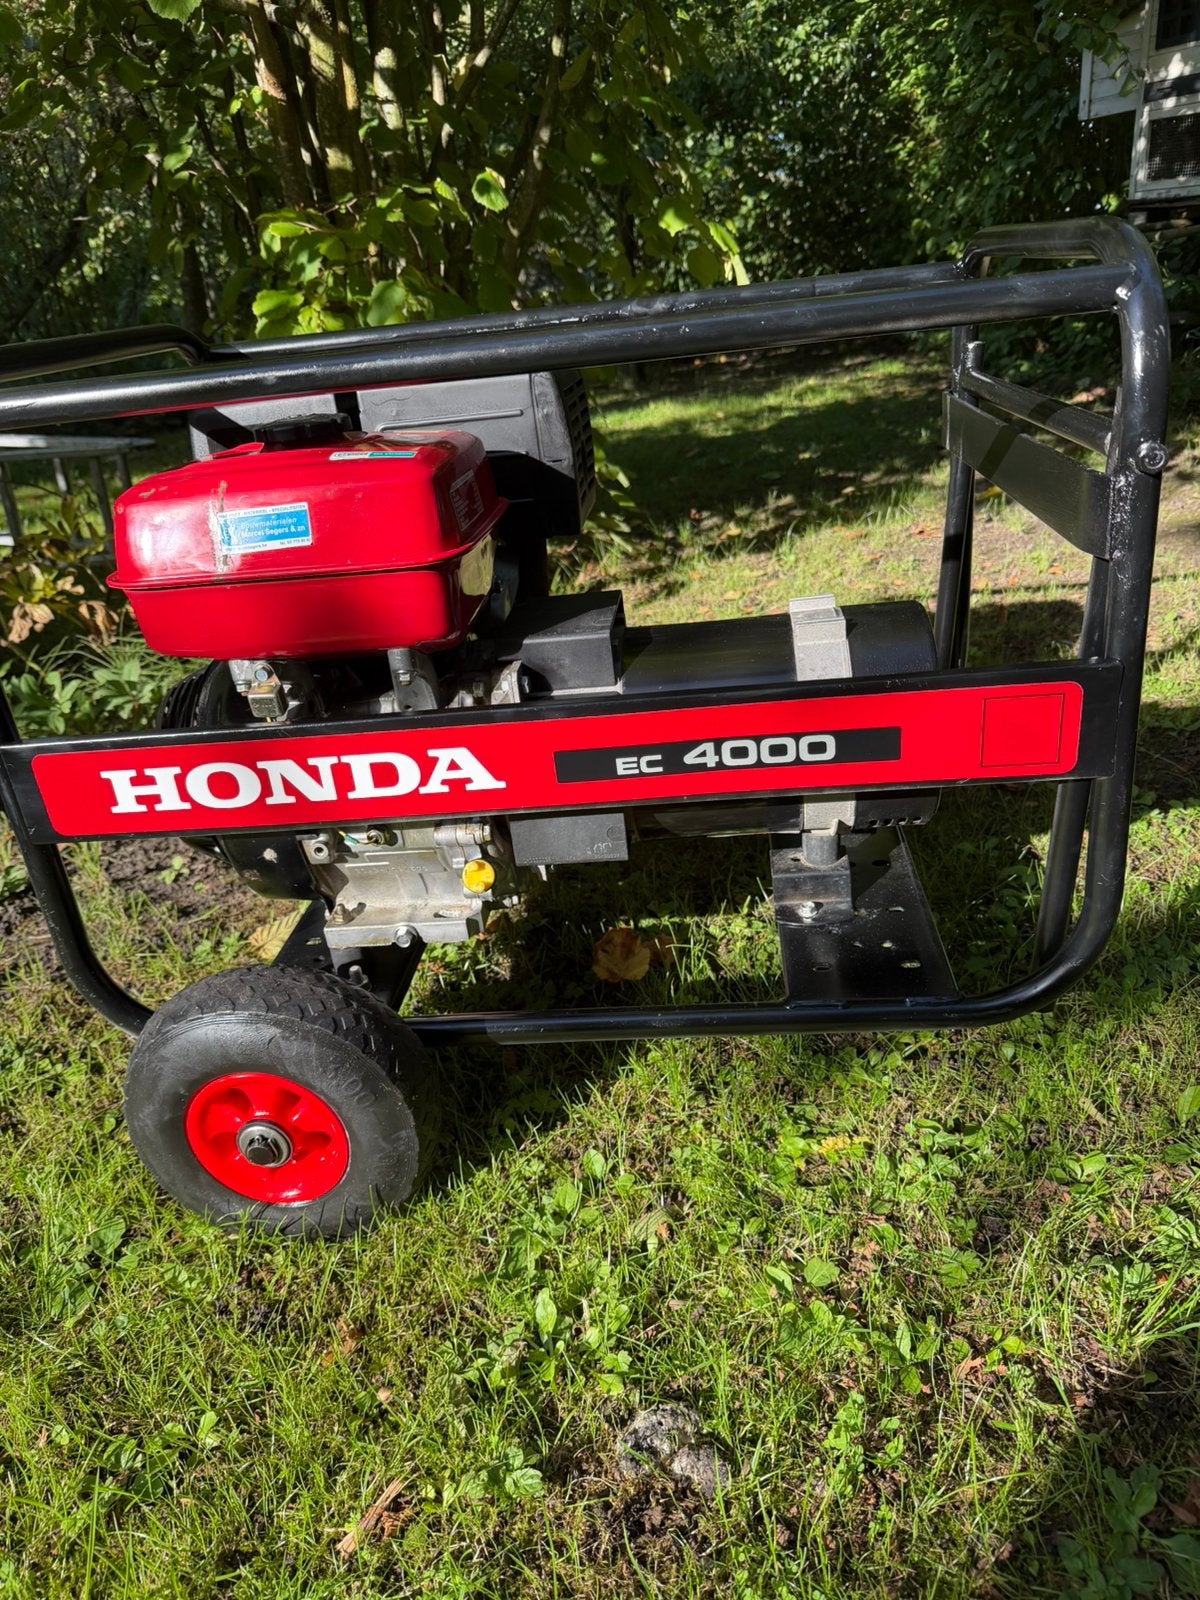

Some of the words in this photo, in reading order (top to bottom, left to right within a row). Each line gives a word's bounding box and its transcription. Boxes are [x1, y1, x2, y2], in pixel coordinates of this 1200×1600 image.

[265, 526, 288, 536] Segers
[290, 525, 297, 533] &
[615, 754, 664, 776] EC
[683, 734, 836, 768] 4000
[99, 746, 507, 814] HONDA
